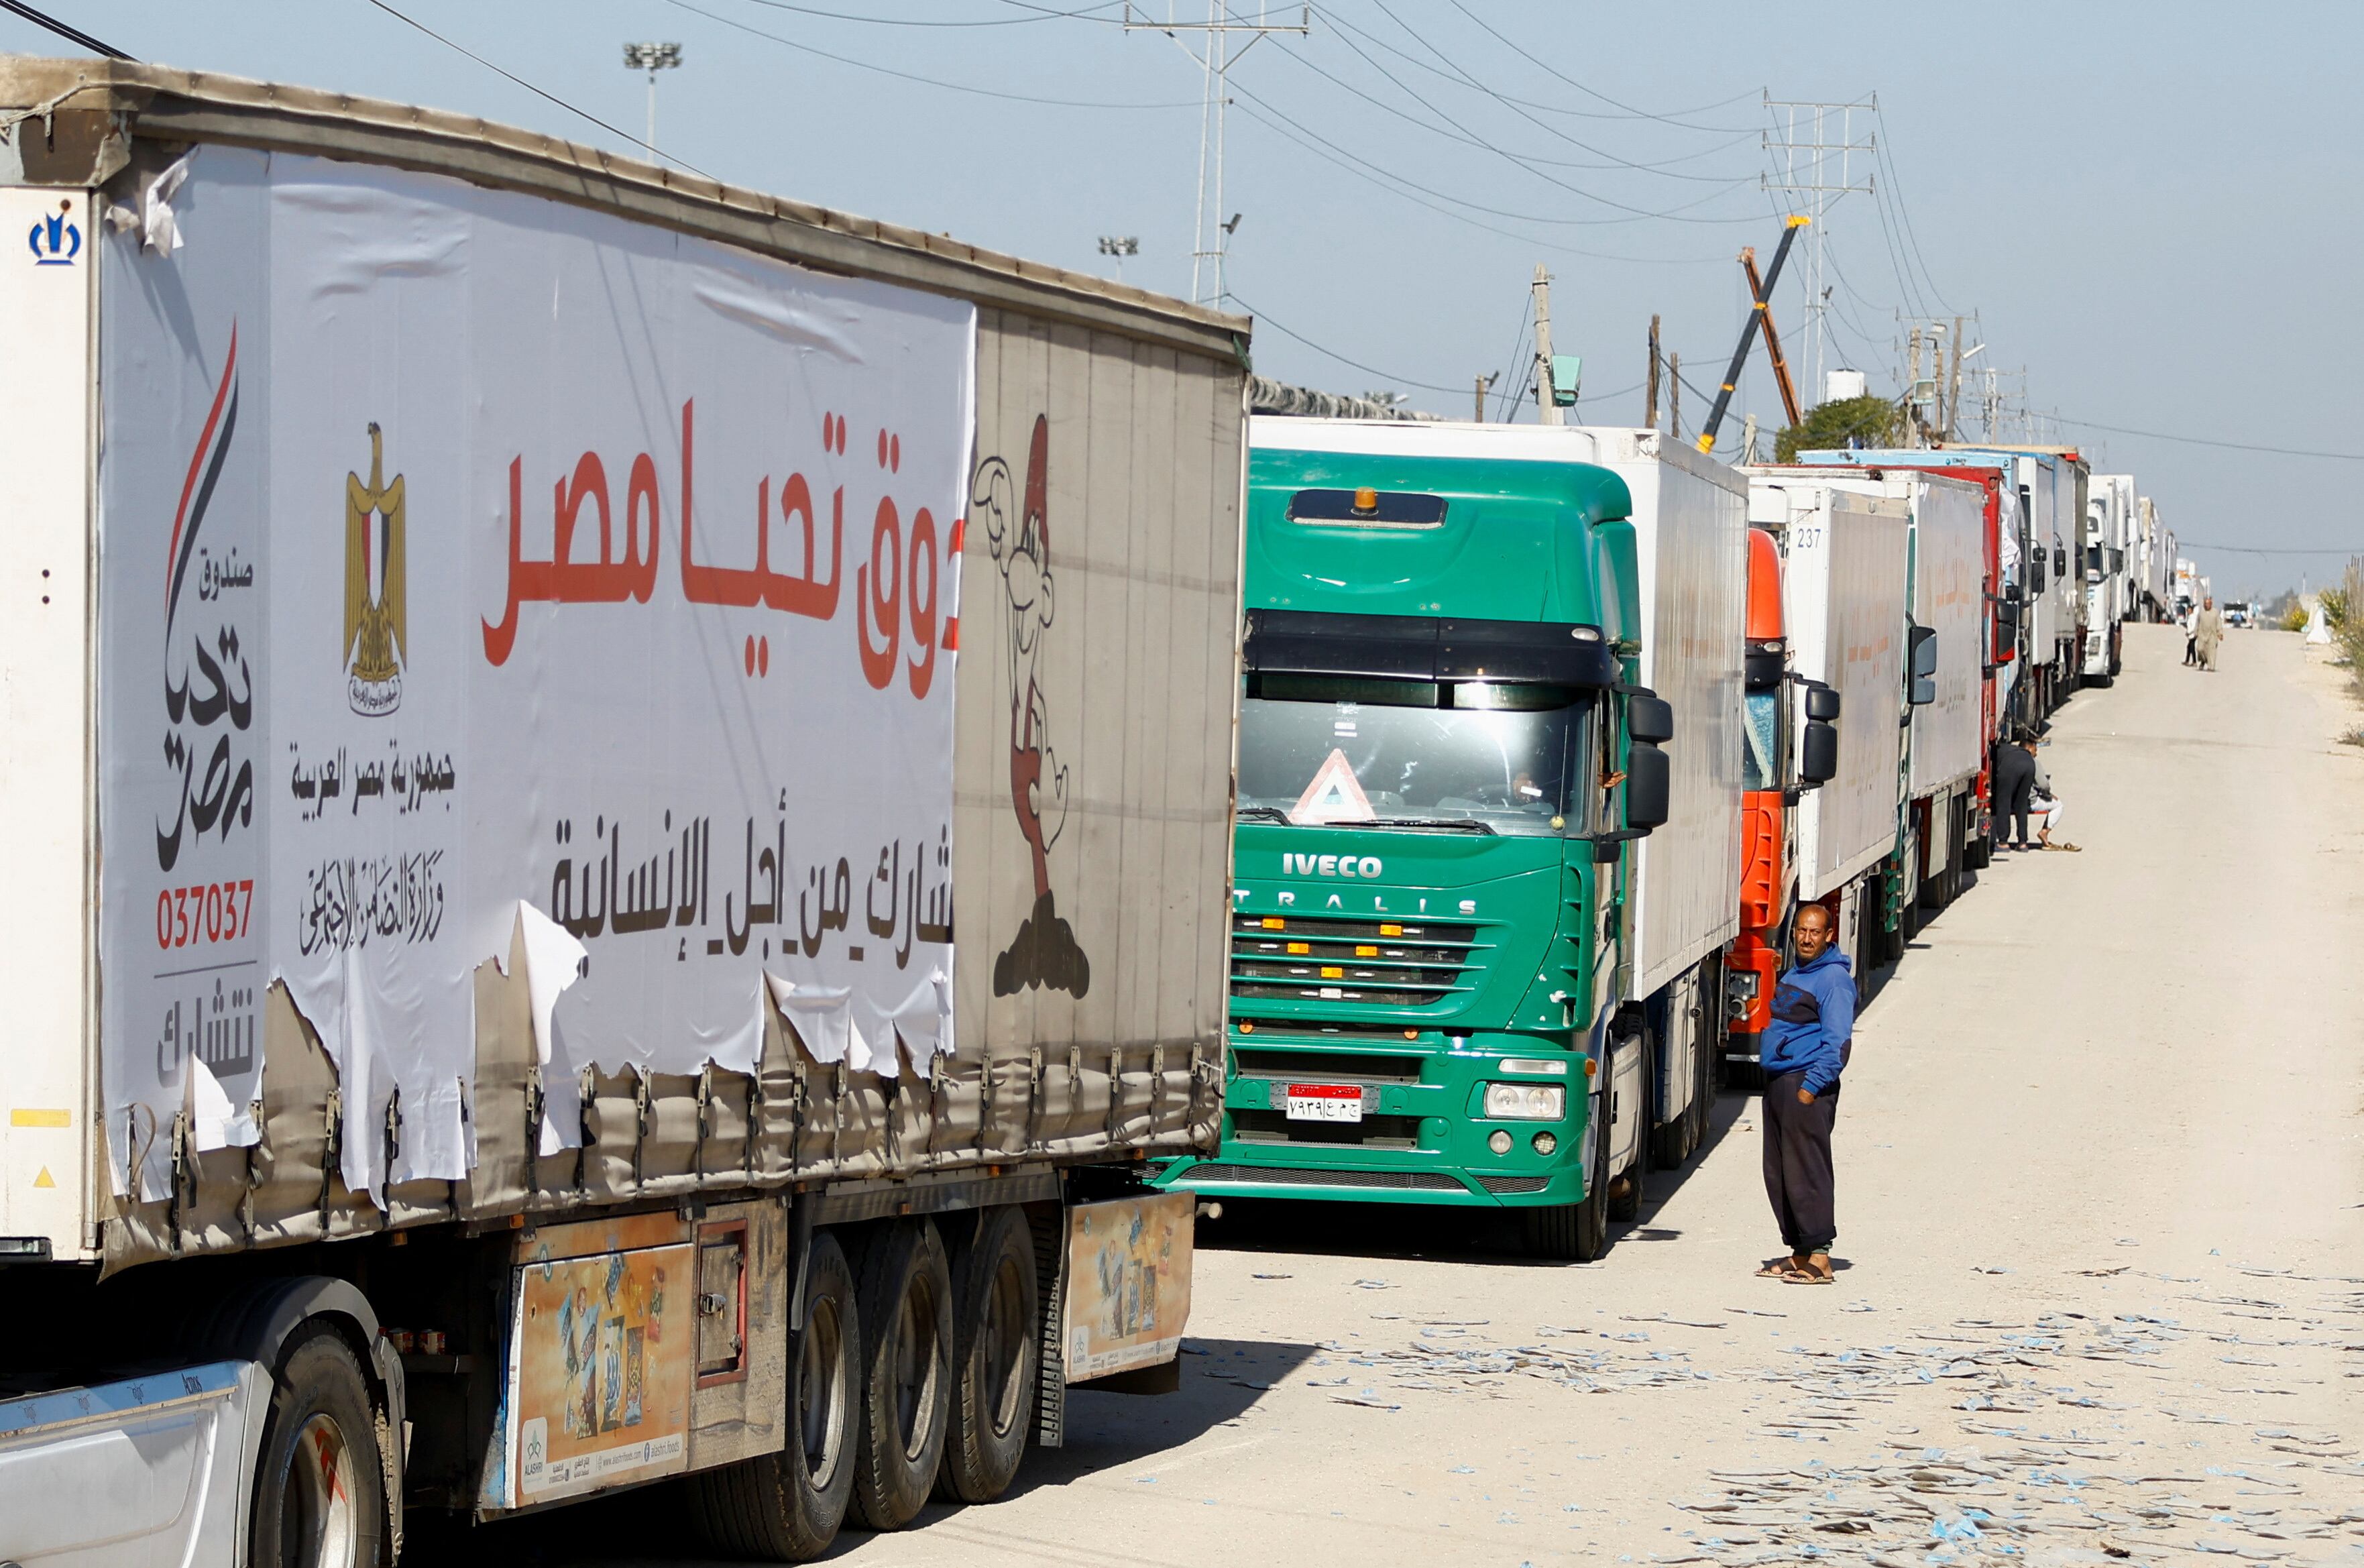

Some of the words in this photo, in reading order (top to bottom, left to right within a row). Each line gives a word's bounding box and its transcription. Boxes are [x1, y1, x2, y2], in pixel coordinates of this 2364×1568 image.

[480, 451, 660, 667] مصر
[680, 396, 846, 679] تحيا
[1797, 528, 1821, 549] 237
[199, 546, 254, 602] صندوق
[156, 733, 252, 872] مصر
[289, 740, 346, 822] العربية
[352, 760, 384, 817] مصر
[389, 738, 455, 814] جمهورية
[1282, 852, 1382, 879] IVECO
[157, 879, 254, 950] 037037
[1233, 889, 1477, 915] TRALIS
[524, 1463, 543, 1477] ALASHRI
